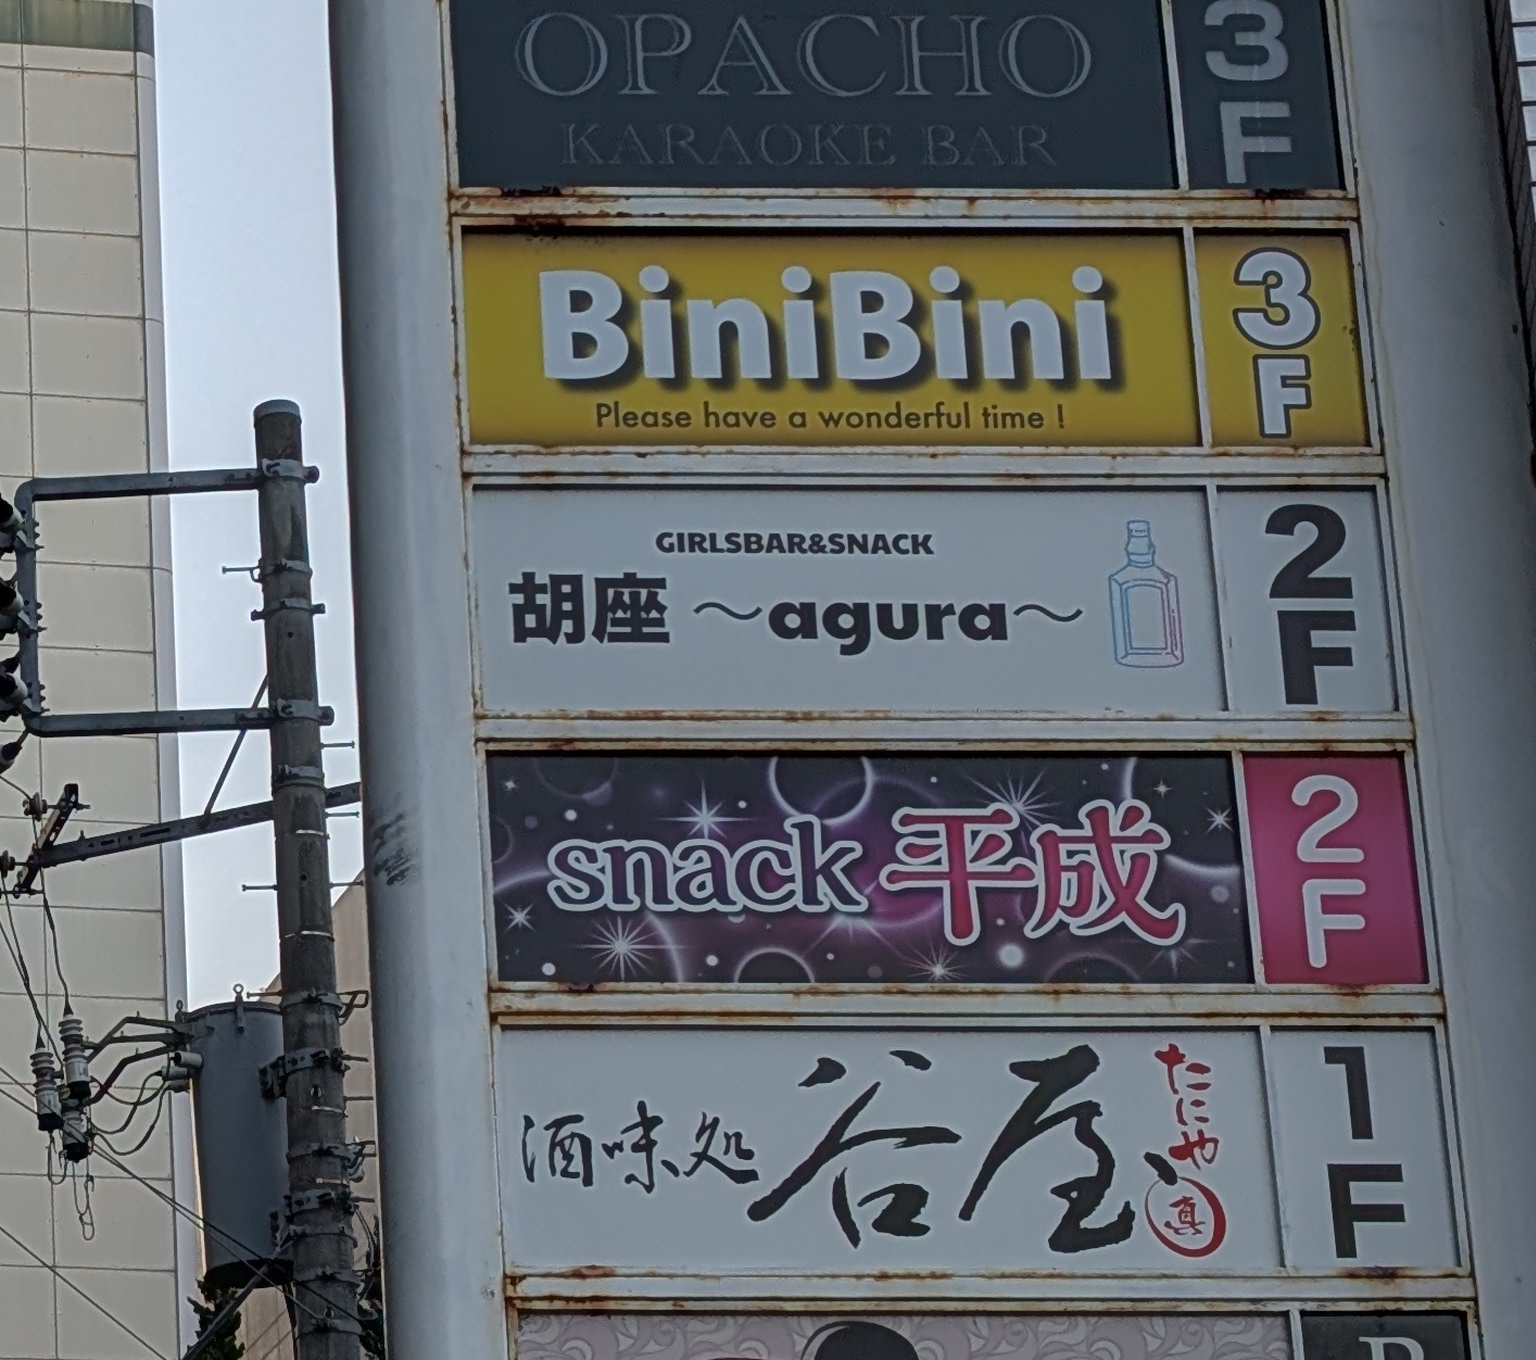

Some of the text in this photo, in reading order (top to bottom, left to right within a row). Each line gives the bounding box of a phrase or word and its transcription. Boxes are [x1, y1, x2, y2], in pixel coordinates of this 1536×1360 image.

[513, 11, 1092, 99] OPACHO
[1204, 0, 1292, 184] 3F
[559, 122, 1059, 168] KARAOKE BAR
[538, 265, 1113, 383] BiniBini
[1234, 247, 1322, 438] 3F
[596, 402, 693, 430] Please
[704, 402, 782, 429] have
[792, 410, 808, 429] a
[818, 402, 972, 429] wonderful
[982, 404, 1046, 429] time
[655, 532, 935, 556] GIRLSBAR&SNACK
[1264, 504, 1357, 706] 2F
[508, 571, 671, 646] 胡座
[547, 799, 1187, 947] snack 平成
[1290, 774, 1367, 970] 2F
[1154, 1043, 1220, 1171] たにや
[1322, 1045, 1408, 1260] 1F
